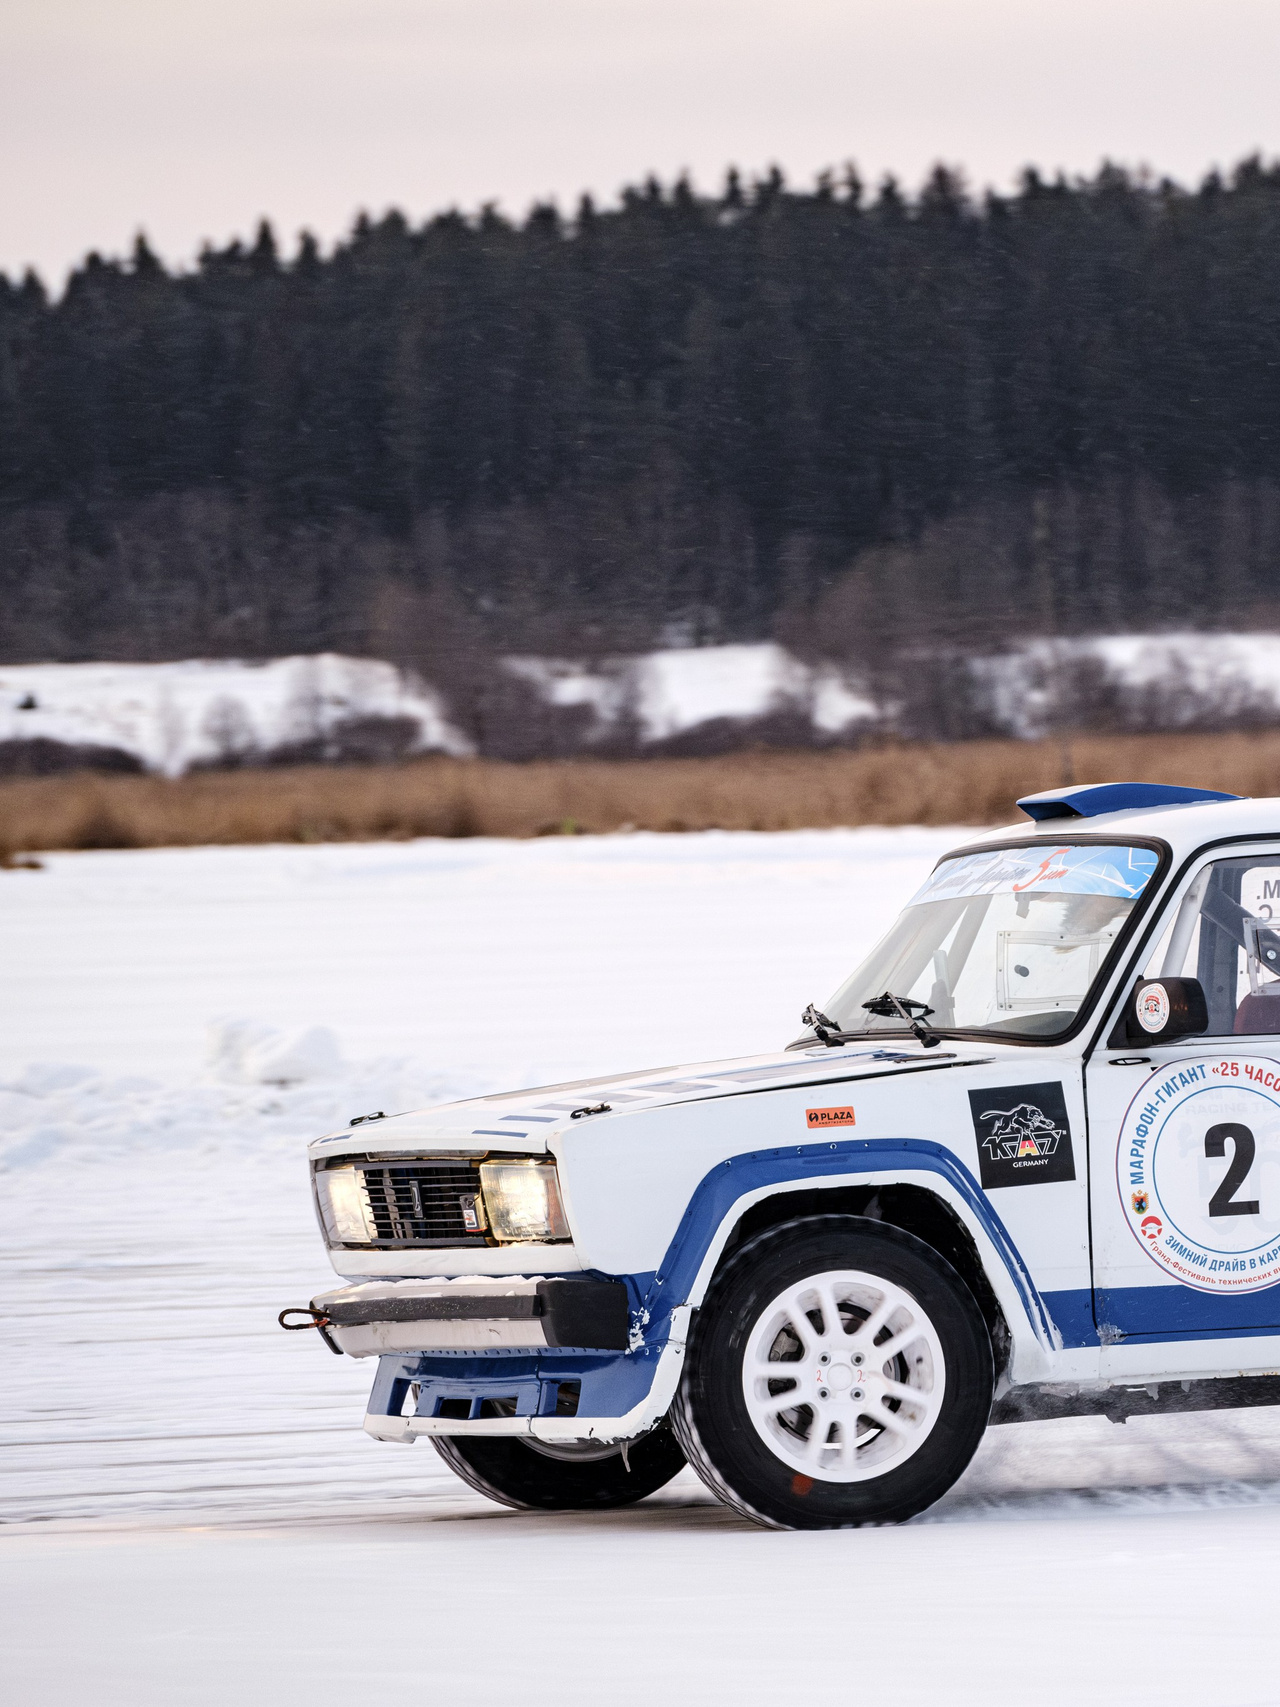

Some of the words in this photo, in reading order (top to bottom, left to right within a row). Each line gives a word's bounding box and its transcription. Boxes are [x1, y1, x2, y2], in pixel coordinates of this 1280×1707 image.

[820, 1111, 853, 1121] PLAZA
[1130, 1064, 1206, 1185] МАРАФОН-ГИГАНТ
[1212, 1062, 1239, 1076] «25
[1013, 1159, 1049, 1168] GERMANY
[1204, 1122, 1260, 1217] 2
[1150, 1240, 1216, 1284] Гранд-Фестиваль
[1219, 1272, 1272, 1285] технических
[1165, 1235, 1208, 1267] ЗИМНИЙ
[1208, 1258, 1246, 1272] ДРАЙВ
[1249, 1258, 1257, 1269] В
